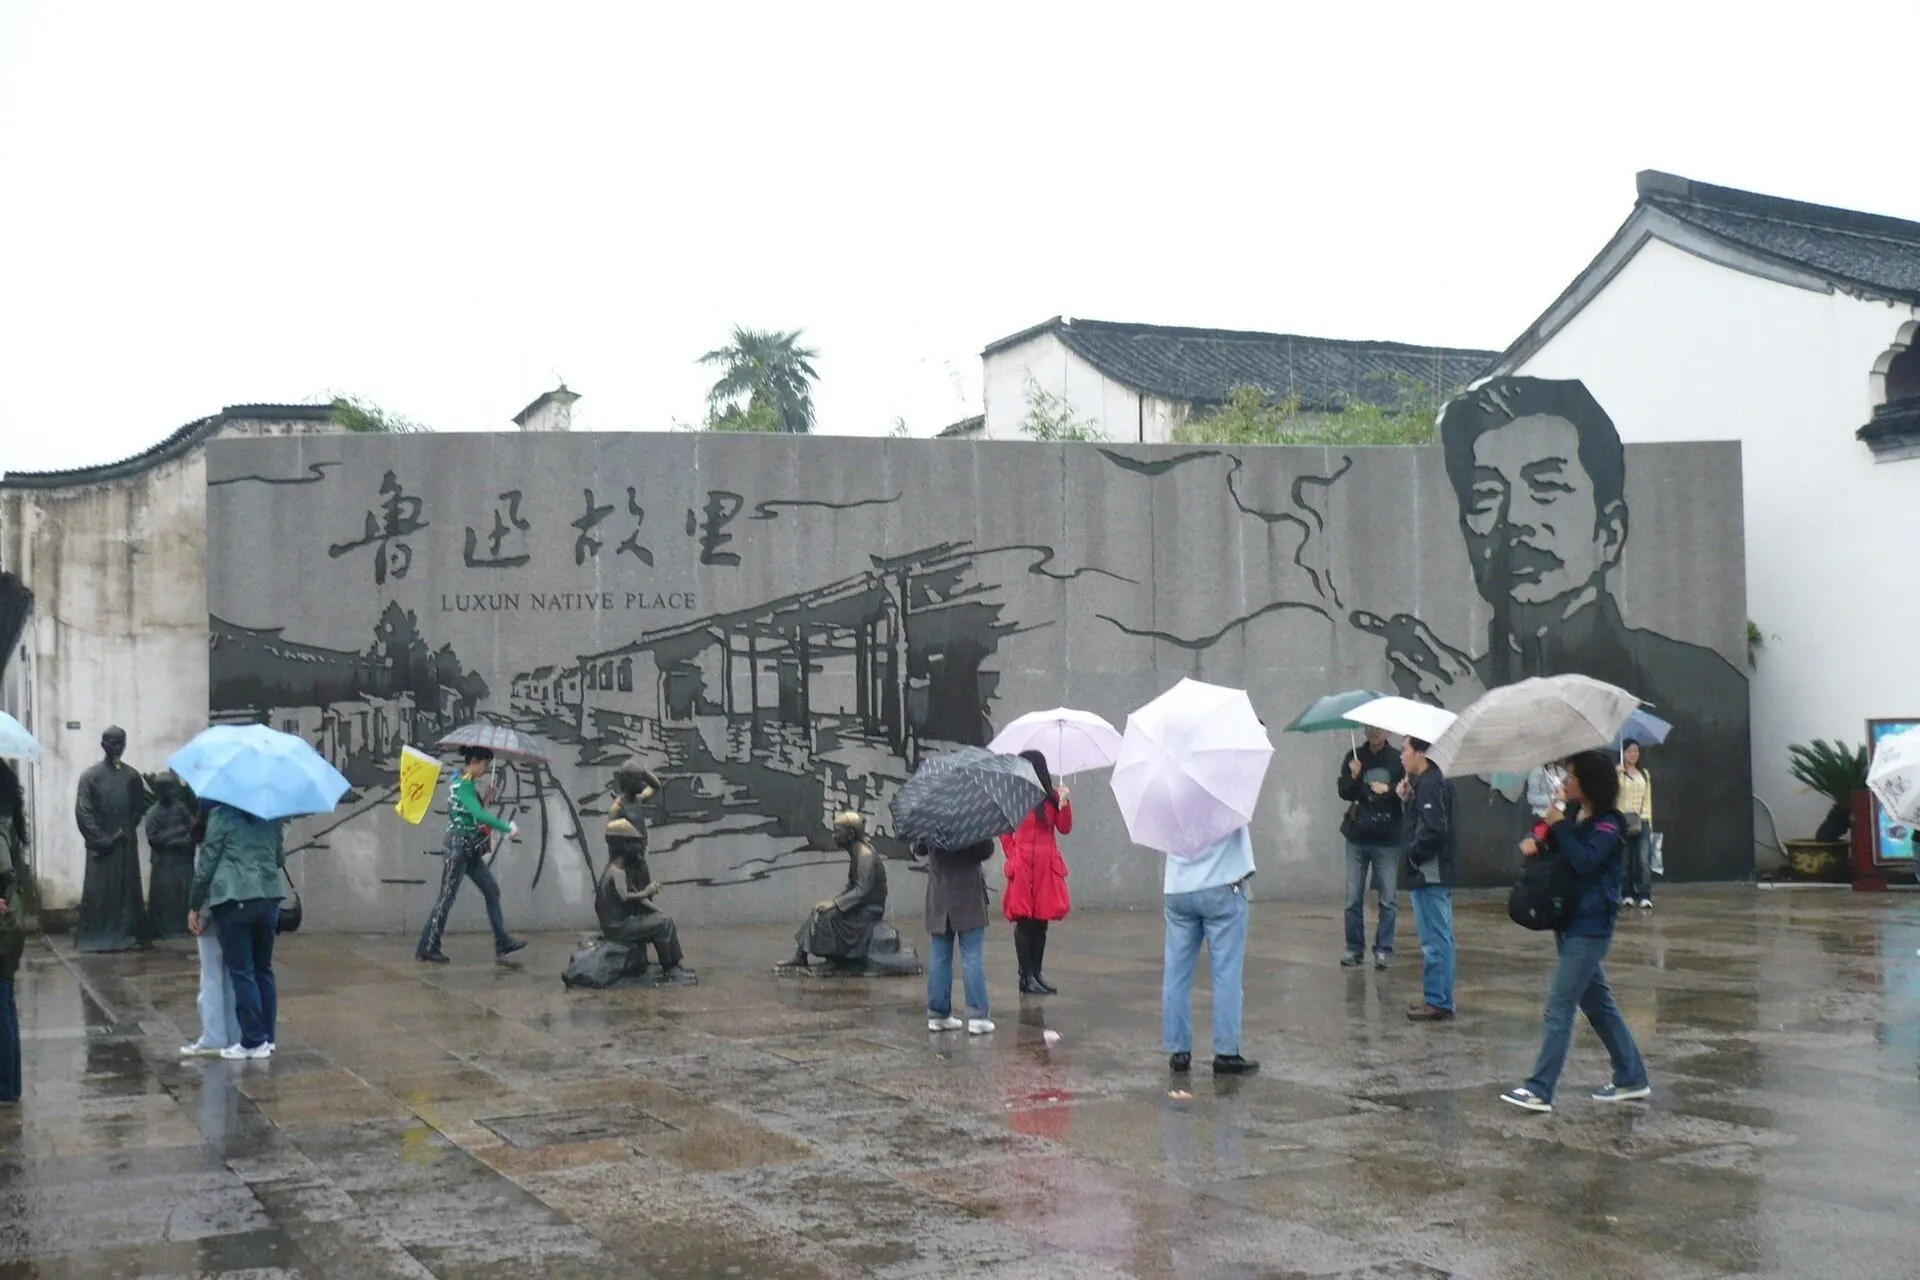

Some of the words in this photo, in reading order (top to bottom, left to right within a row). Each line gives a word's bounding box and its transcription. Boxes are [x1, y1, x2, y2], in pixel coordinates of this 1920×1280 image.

[441, 593, 521, 612] LUXUN
[529, 592, 614, 611] NATIVE
[624, 592, 697, 610] PLACE
